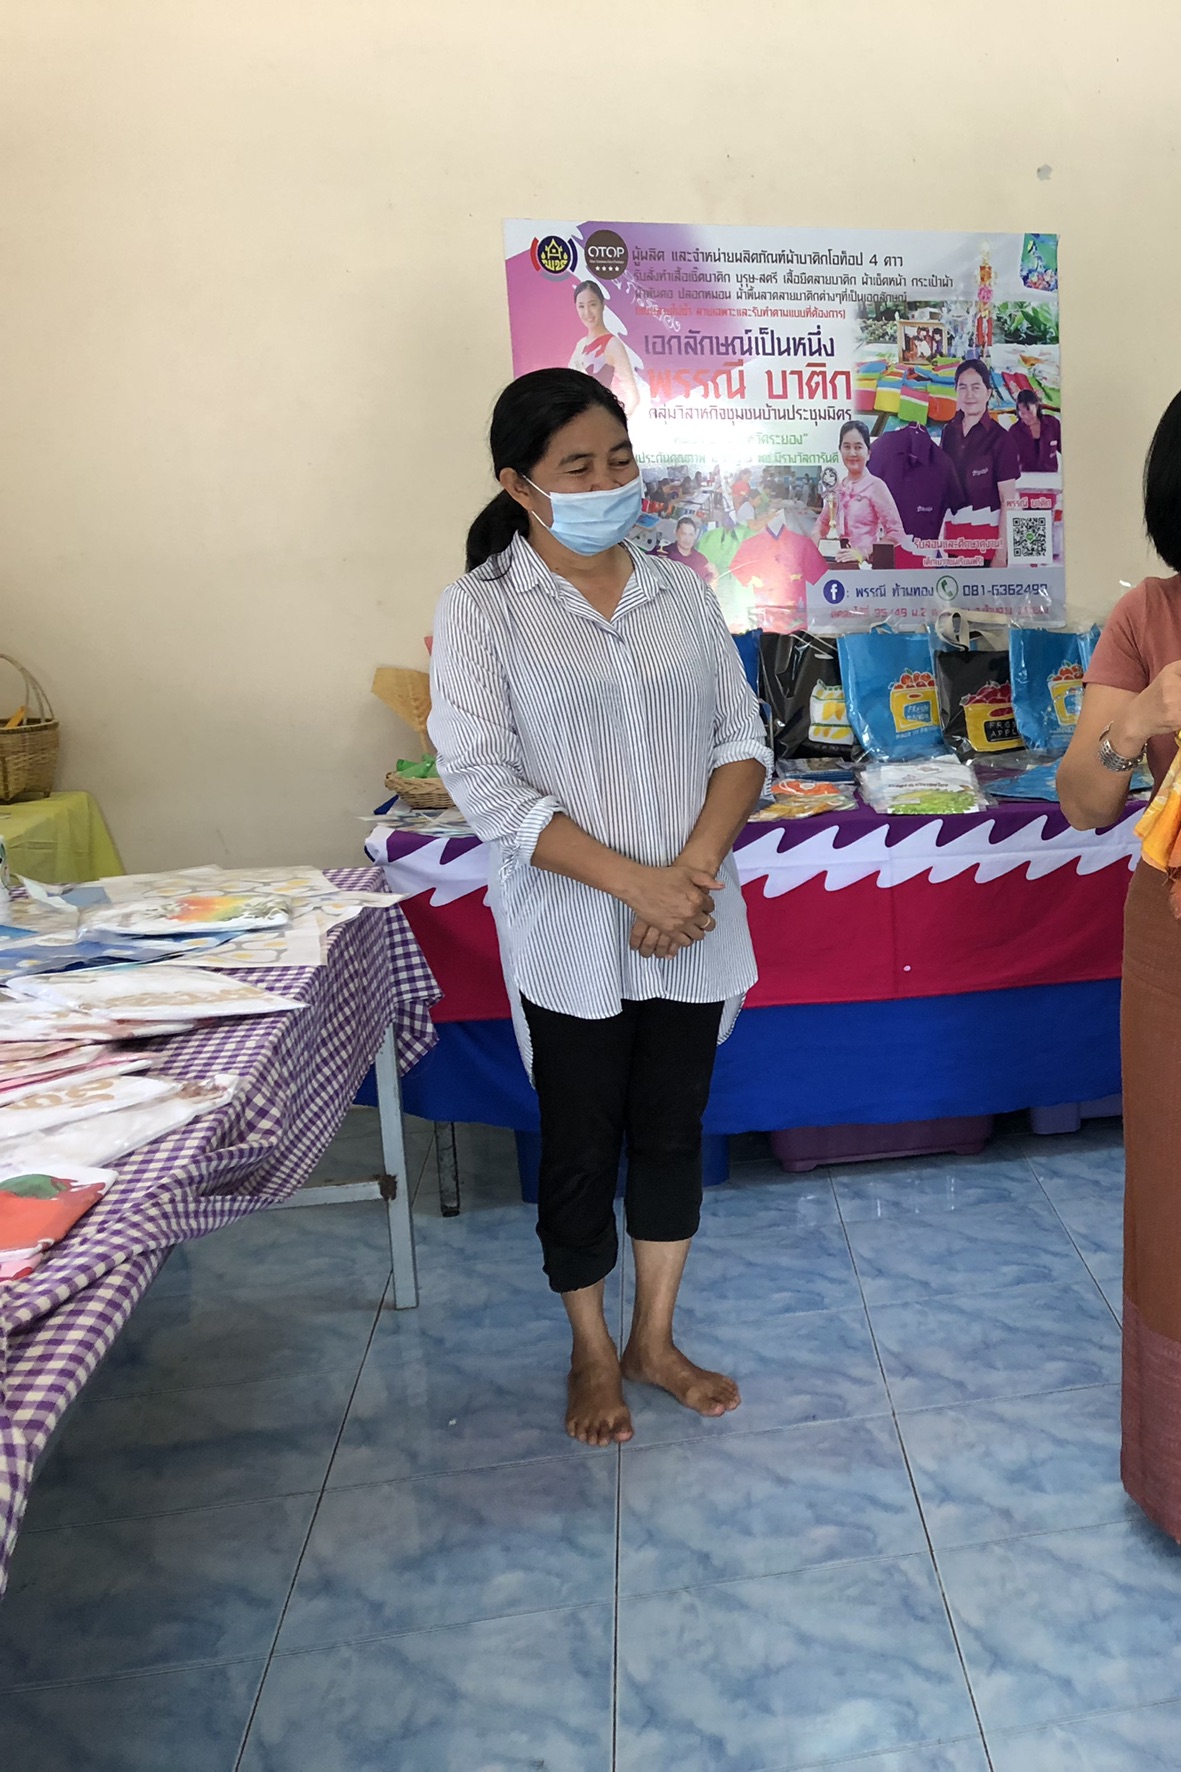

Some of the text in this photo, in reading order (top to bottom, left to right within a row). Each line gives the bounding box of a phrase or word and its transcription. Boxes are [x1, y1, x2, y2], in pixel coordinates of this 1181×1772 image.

[588, 245, 625, 258] OTOP
[632, 246, 665, 266] ผู้ผลิต
[869, 253, 878, 266] 4
[884, 255, 904, 267] ดาว
[735, 271, 778, 288] บุรุษ-สตรี
[861, 272, 907, 287] ผ้าเช็ดหน้า
[677, 287, 731, 300] ปลอกหมอน
[644, 324, 835, 357] เอกลักษณ์เป็นหนึ่ง
[646, 358, 852, 400] พรรณี บาติก
[855, 584, 886, 598] พรรณี
